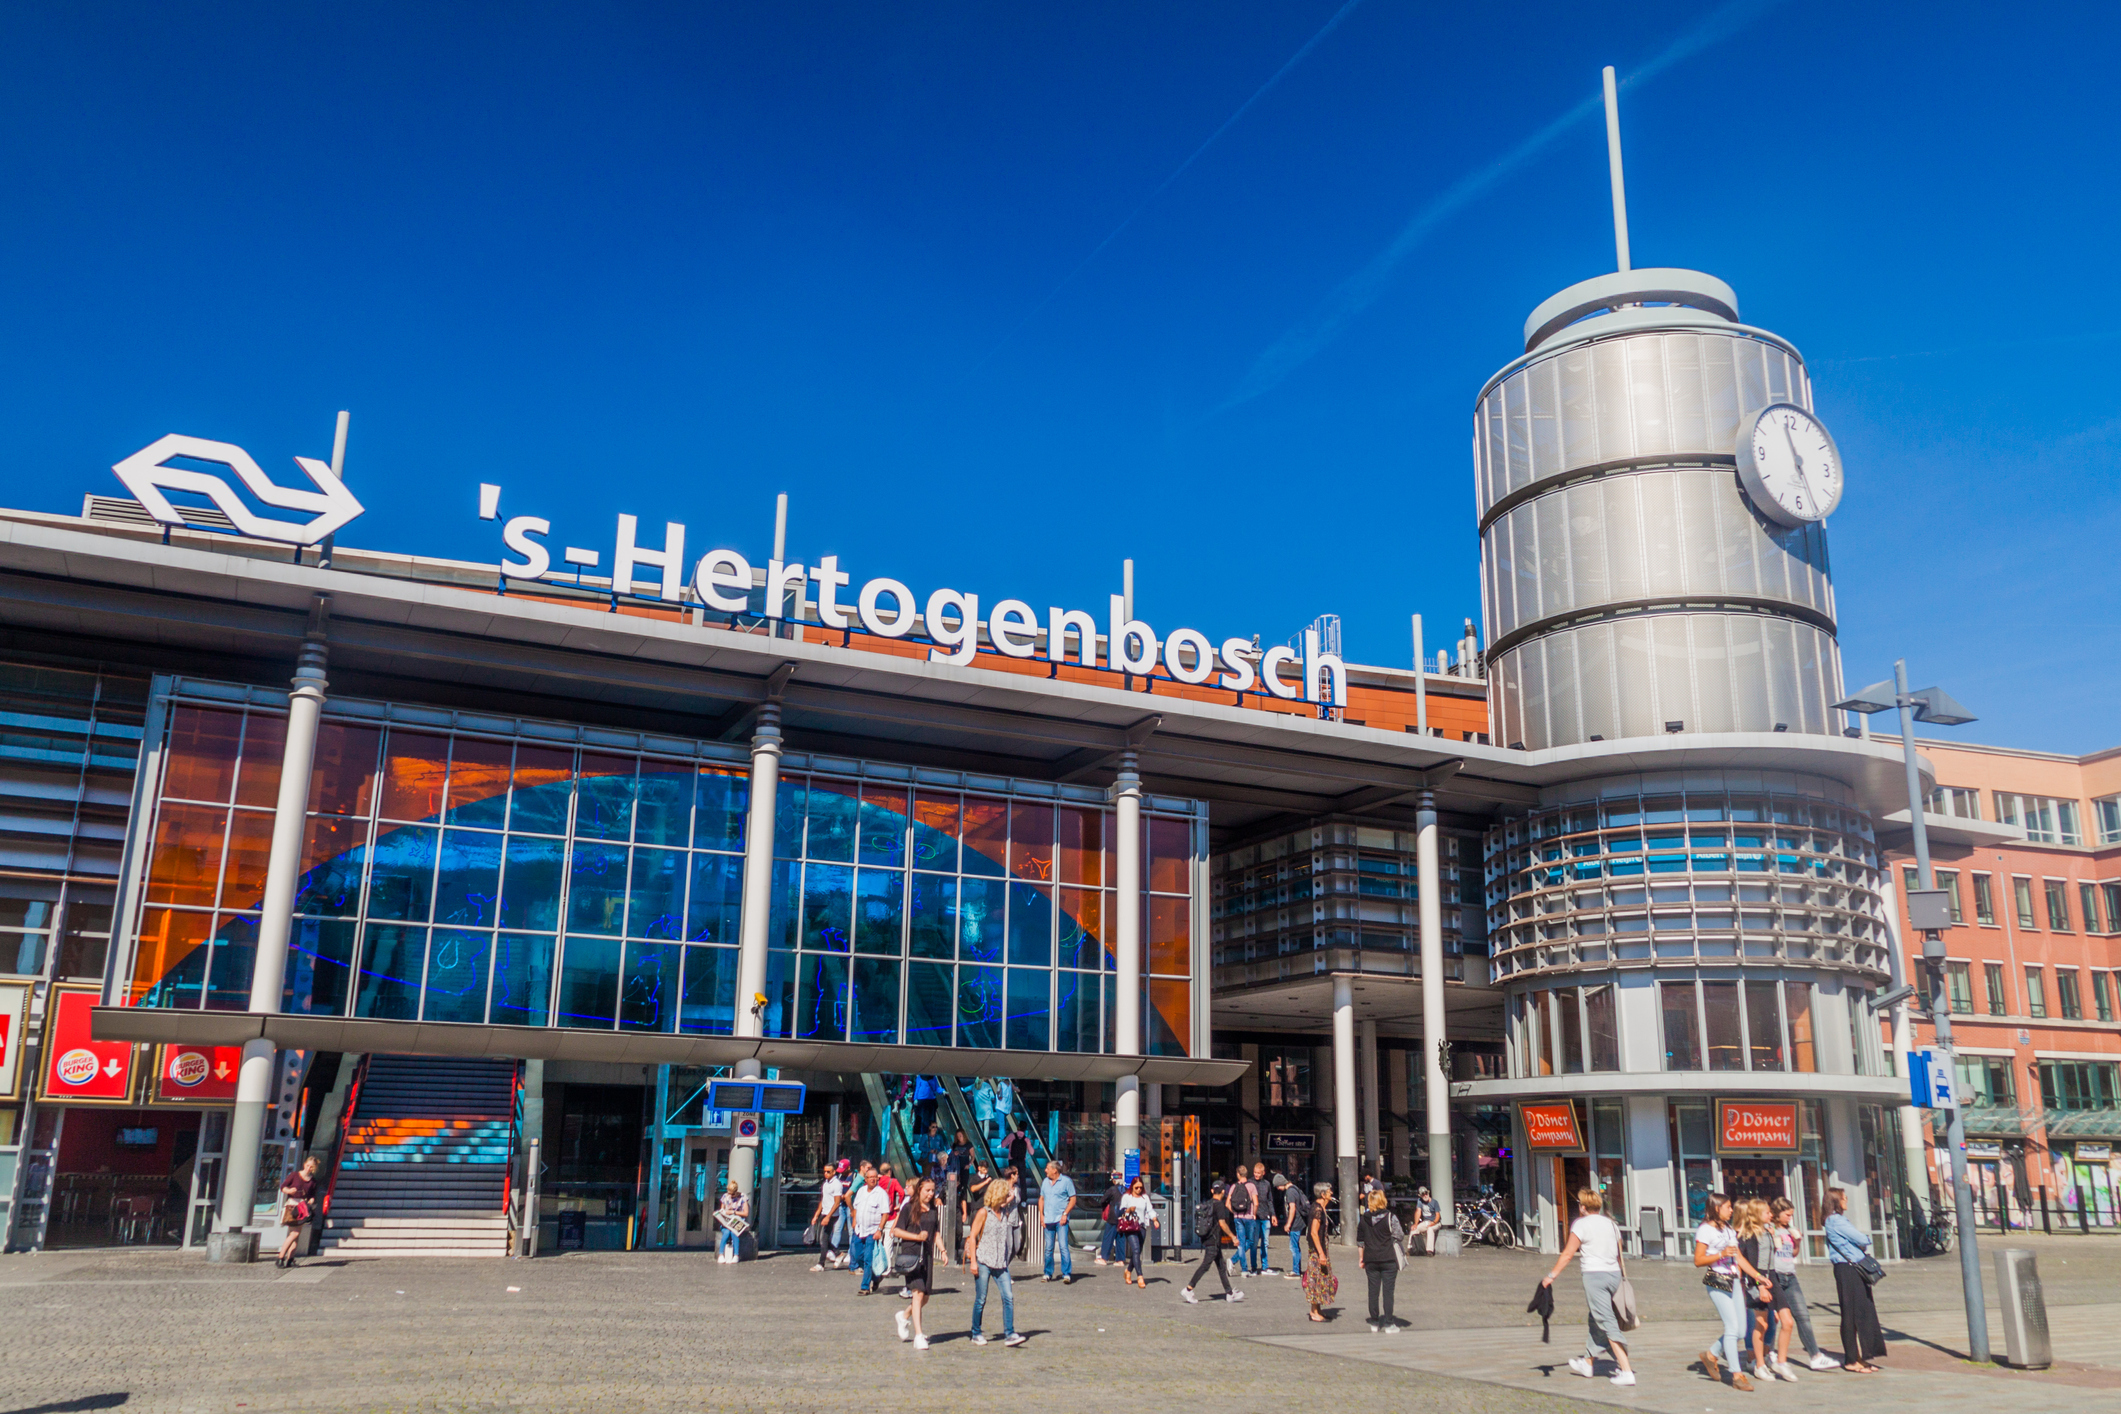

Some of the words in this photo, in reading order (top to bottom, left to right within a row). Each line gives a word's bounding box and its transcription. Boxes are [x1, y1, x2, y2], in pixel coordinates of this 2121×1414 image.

[1784, 415, 1797, 431] 12
[1758, 446, 1766, 461] 9
[1823, 463, 1830, 478] 3
[1795, 495, 1803, 510] 6
[479, 482, 1348, 708] 's-Hertogenbosch
[63, 1056, 94, 1068] BURGER
[63, 1062, 94, 1076] KING
[175, 1059, 205, 1070] BURGER
[175, 1065, 205, 1079] KING
[1536, 1113, 1568, 1127] Döner
[1742, 1112, 1791, 1127] Döner
[1530, 1129, 1574, 1144] Company
[1726, 1128, 1791, 1145] Company
